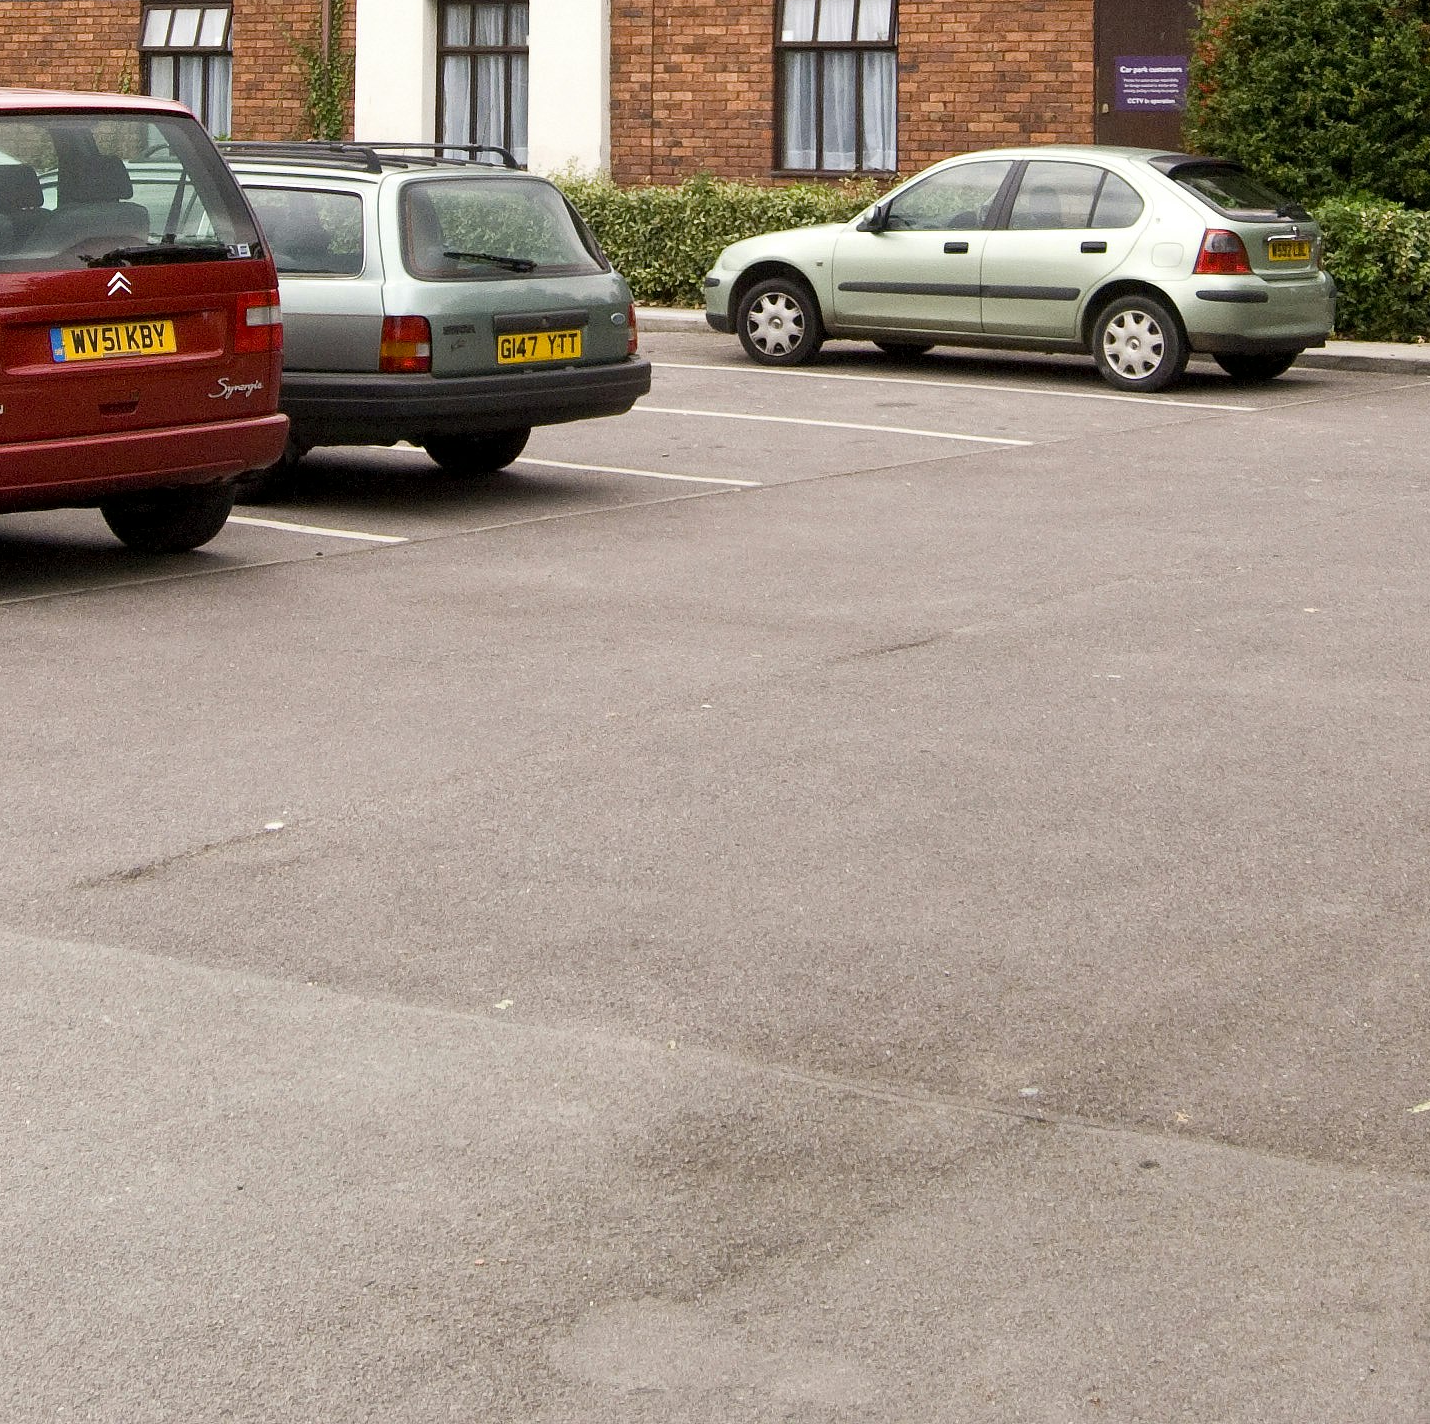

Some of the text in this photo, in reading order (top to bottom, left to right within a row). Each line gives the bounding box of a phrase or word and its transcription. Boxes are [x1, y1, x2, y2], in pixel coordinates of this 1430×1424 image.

[71, 323, 165, 354] WV51 KBY
[501, 333, 577, 358] G147 YTT
